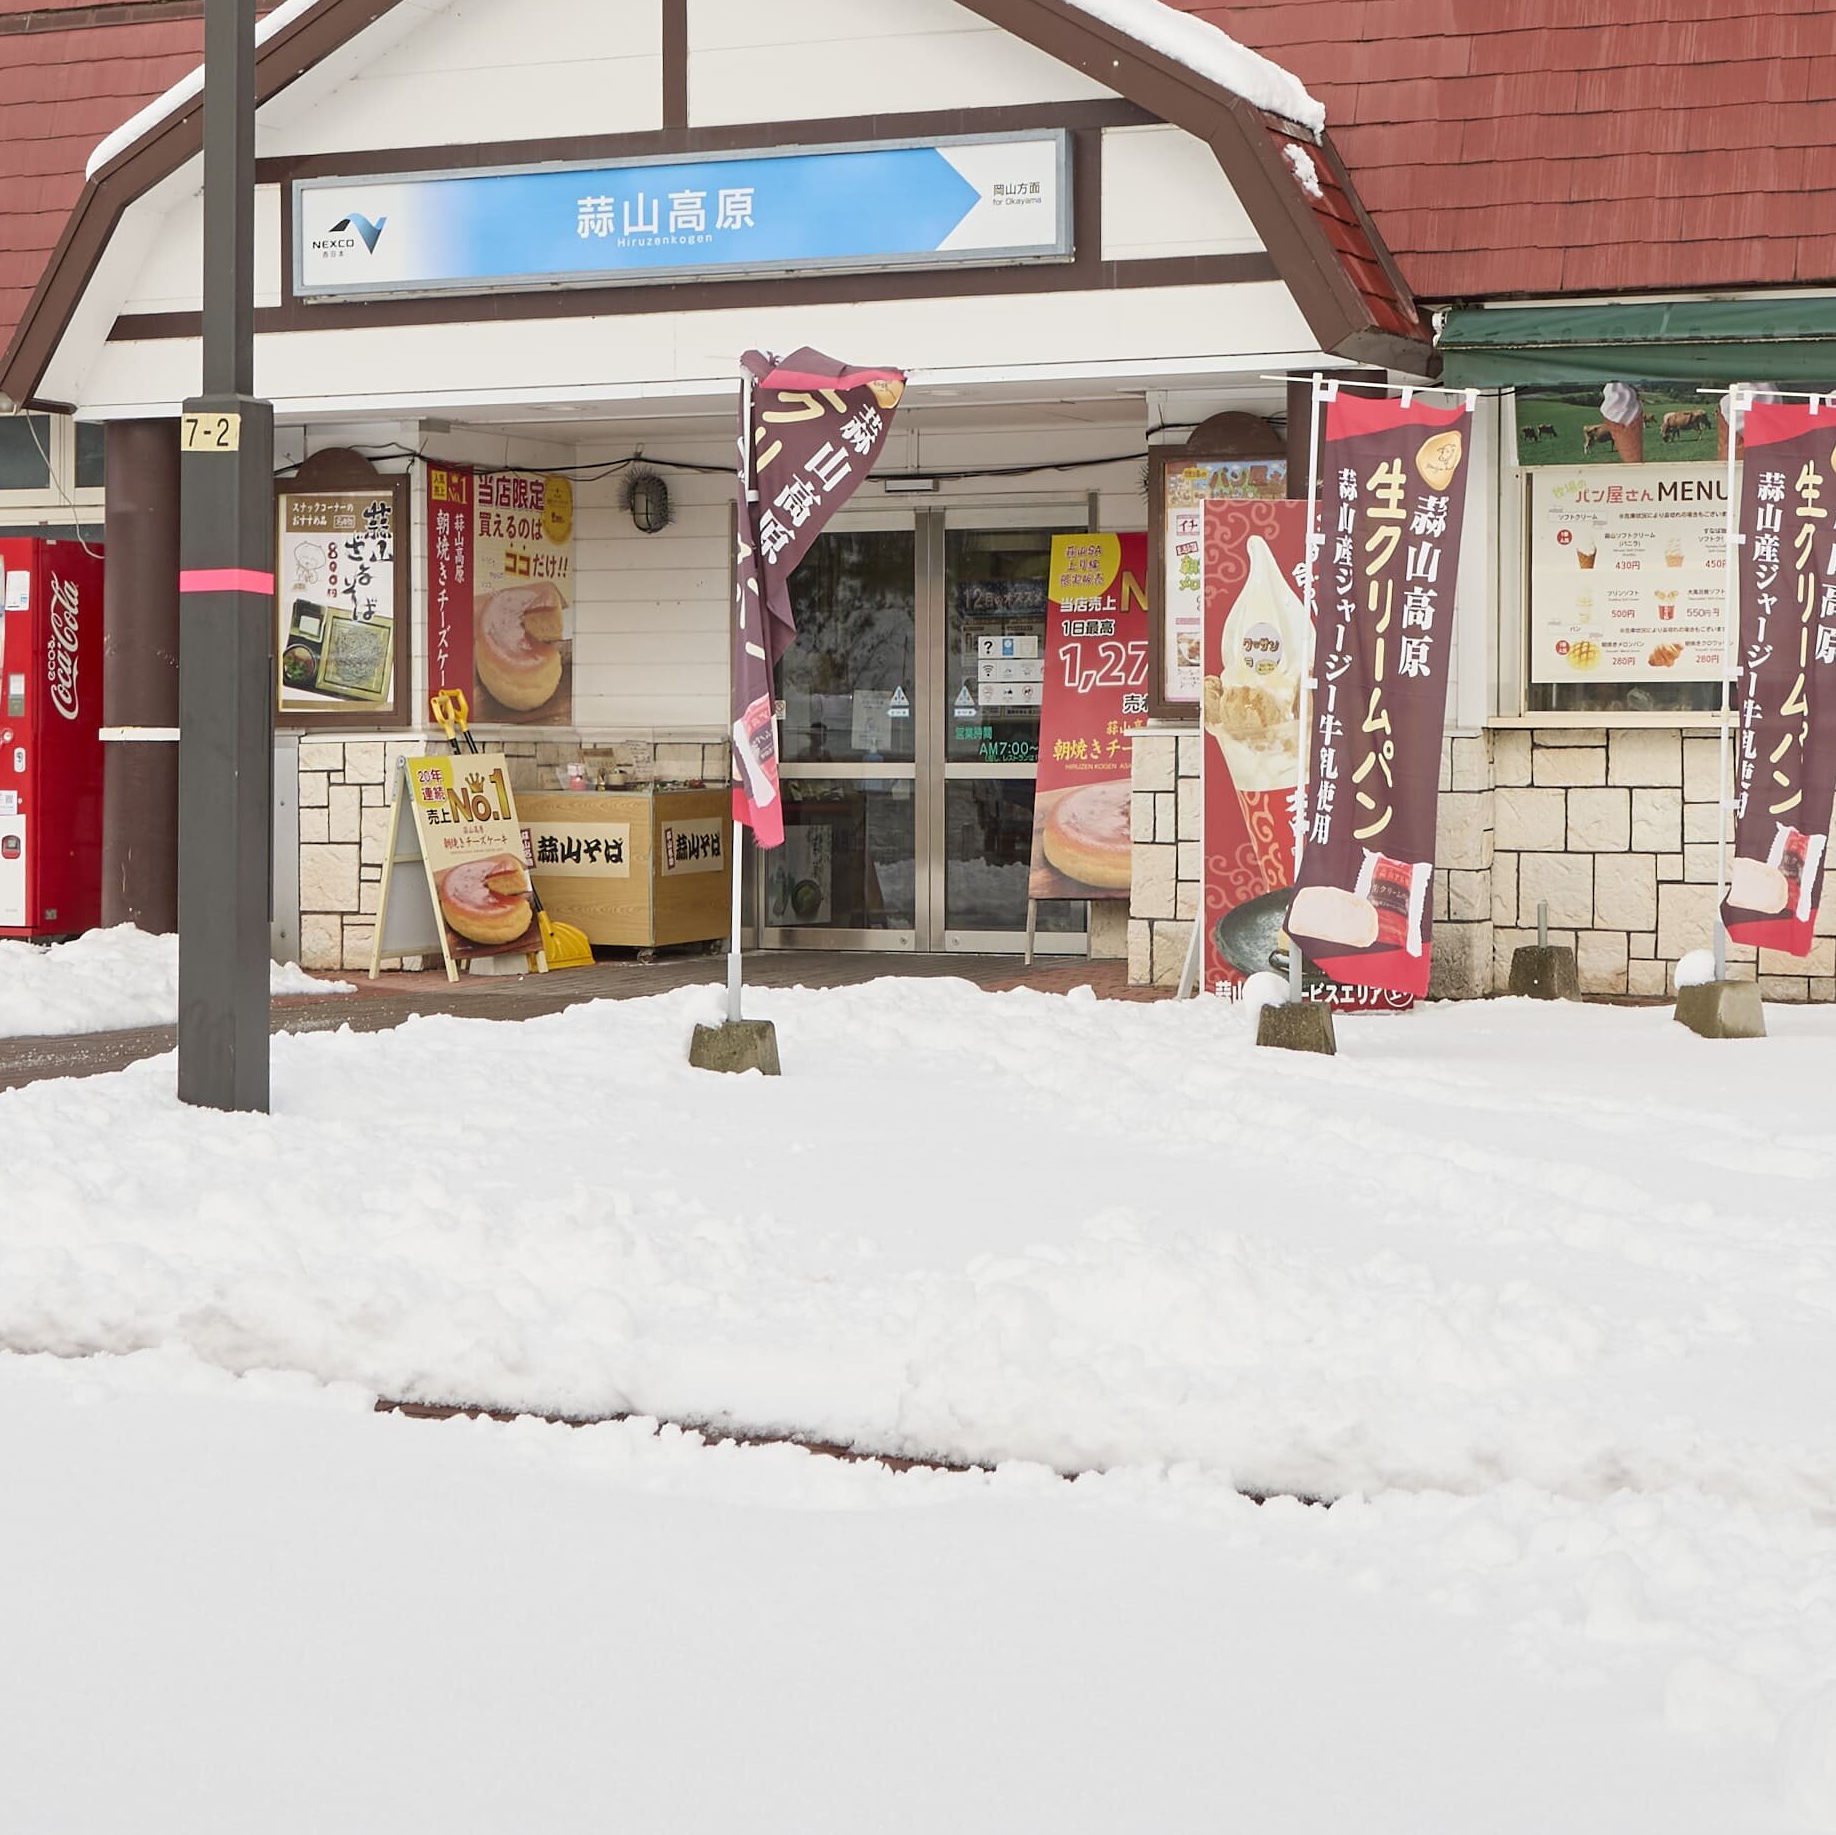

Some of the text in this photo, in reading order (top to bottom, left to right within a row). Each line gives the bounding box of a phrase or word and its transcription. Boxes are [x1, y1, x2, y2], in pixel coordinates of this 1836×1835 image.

[993, 181, 1041, 197] 岡山方面
[993, 195, 1042, 207] for Okayama
[576, 187, 756, 239] 蒜山高原
[312, 239, 355, 250] NEXCO
[617, 234, 713, 248] Hiruzenkogen
[322, 250, 345, 258] 西日本
[185, 418, 231, 448] 7-2
[478, 475, 544, 511] 当店限定
[1575, 485, 1654, 504] パン屋さん
[478, 512, 543, 540] 買えるのは
[453, 514, 465, 582] 蒜山高原
[1615, 560, 1641, 570] 430円
[1398, 494, 1450, 678] 蒜山高原
[1060, 596, 1117, 613] 当店売上
[1611, 609, 1635, 618] 500円
[1062, 620, 1115, 637] 1日最高
[1309, 467, 1359, 845] 蒜山産ジャージー牛乳使用
[1351, 457, 1408, 841] 生クリームパン
[1696, 654, 1720, 664] 280円
[417, 768, 443, 784] 20年
[421, 786, 446, 802] 連続
[446, 767, 512, 824] No.1
[427, 807, 453, 826] 売上
[537, 835, 624, 864] 蒜山そば
[676, 832, 721, 861] 蒜山そば
